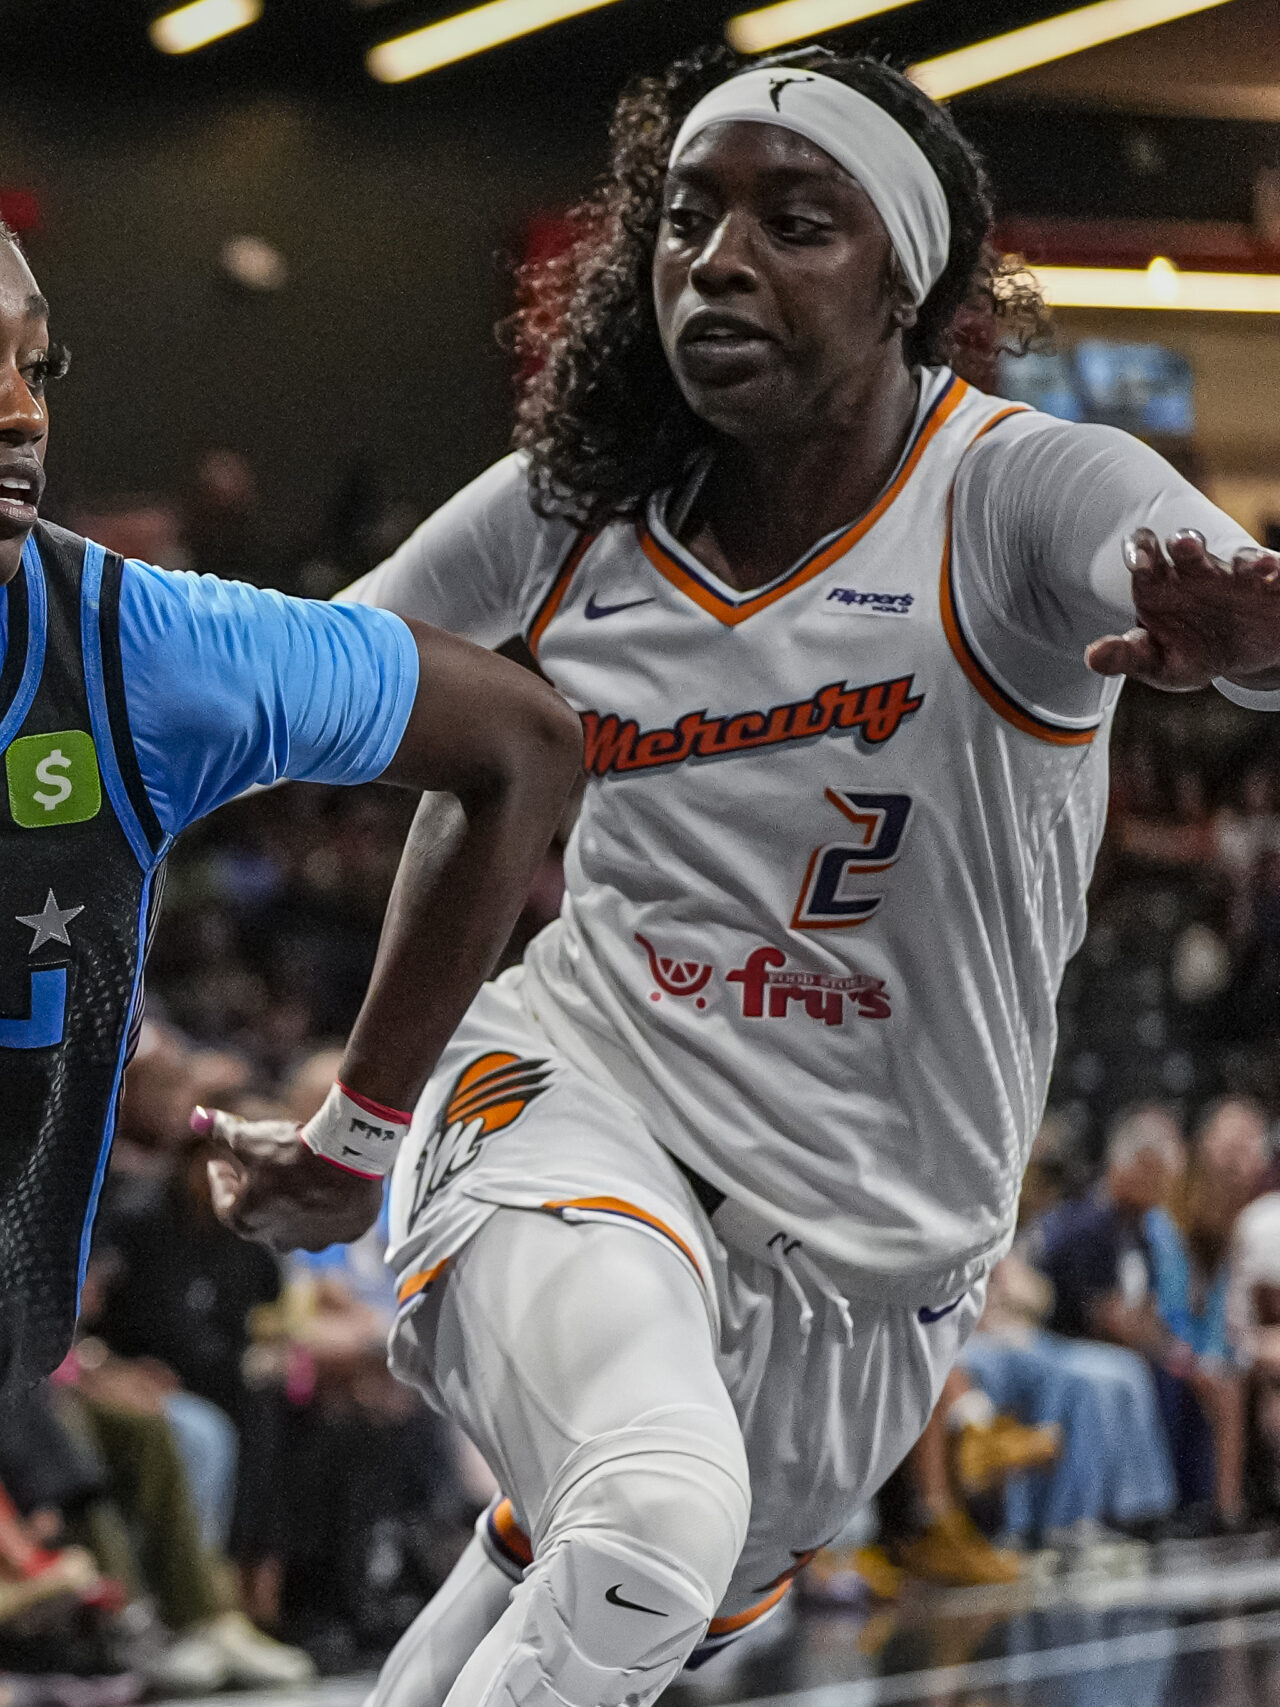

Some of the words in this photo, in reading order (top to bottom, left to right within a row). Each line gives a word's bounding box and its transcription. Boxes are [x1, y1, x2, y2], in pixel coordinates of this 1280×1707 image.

[578, 673, 926, 778] Mercury
[33, 749, 73, 811] $
[789, 786, 914, 930] 2
[725, 946, 892, 1026] fry's
